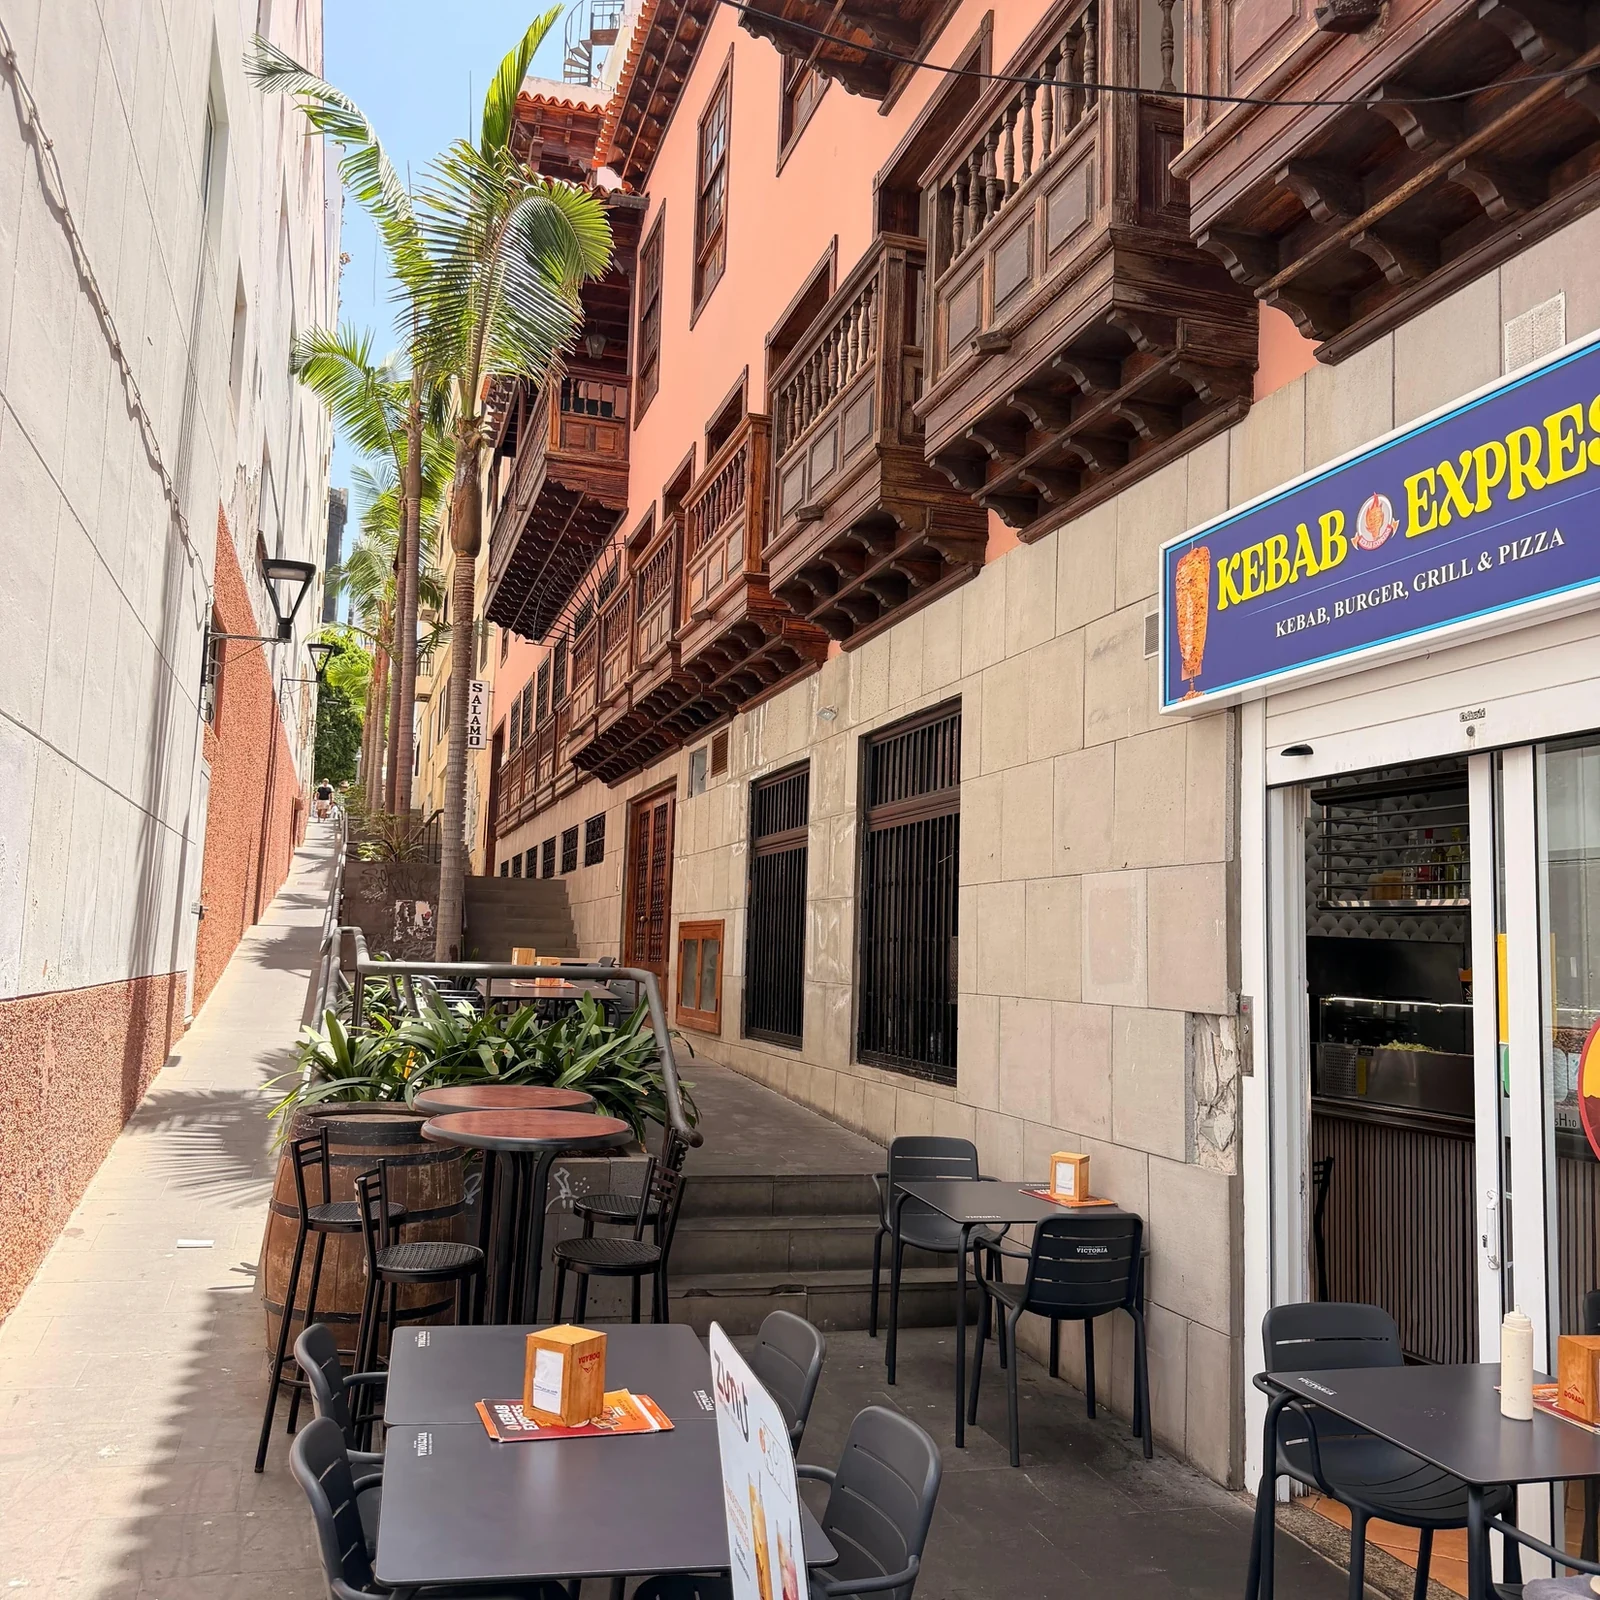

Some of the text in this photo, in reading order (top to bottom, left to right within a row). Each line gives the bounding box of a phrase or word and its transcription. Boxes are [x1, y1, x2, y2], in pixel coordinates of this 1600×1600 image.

[1216, 509, 1348, 611] KEBAB
[1275, 527, 1565, 638] KEBAB, BURGER, GRILL & PIZZA
[578, 1351, 601, 1364] DORADA
[1563, 1390, 1586, 1406] DORADA
[494, 1404, 520, 1425] KEBAB
